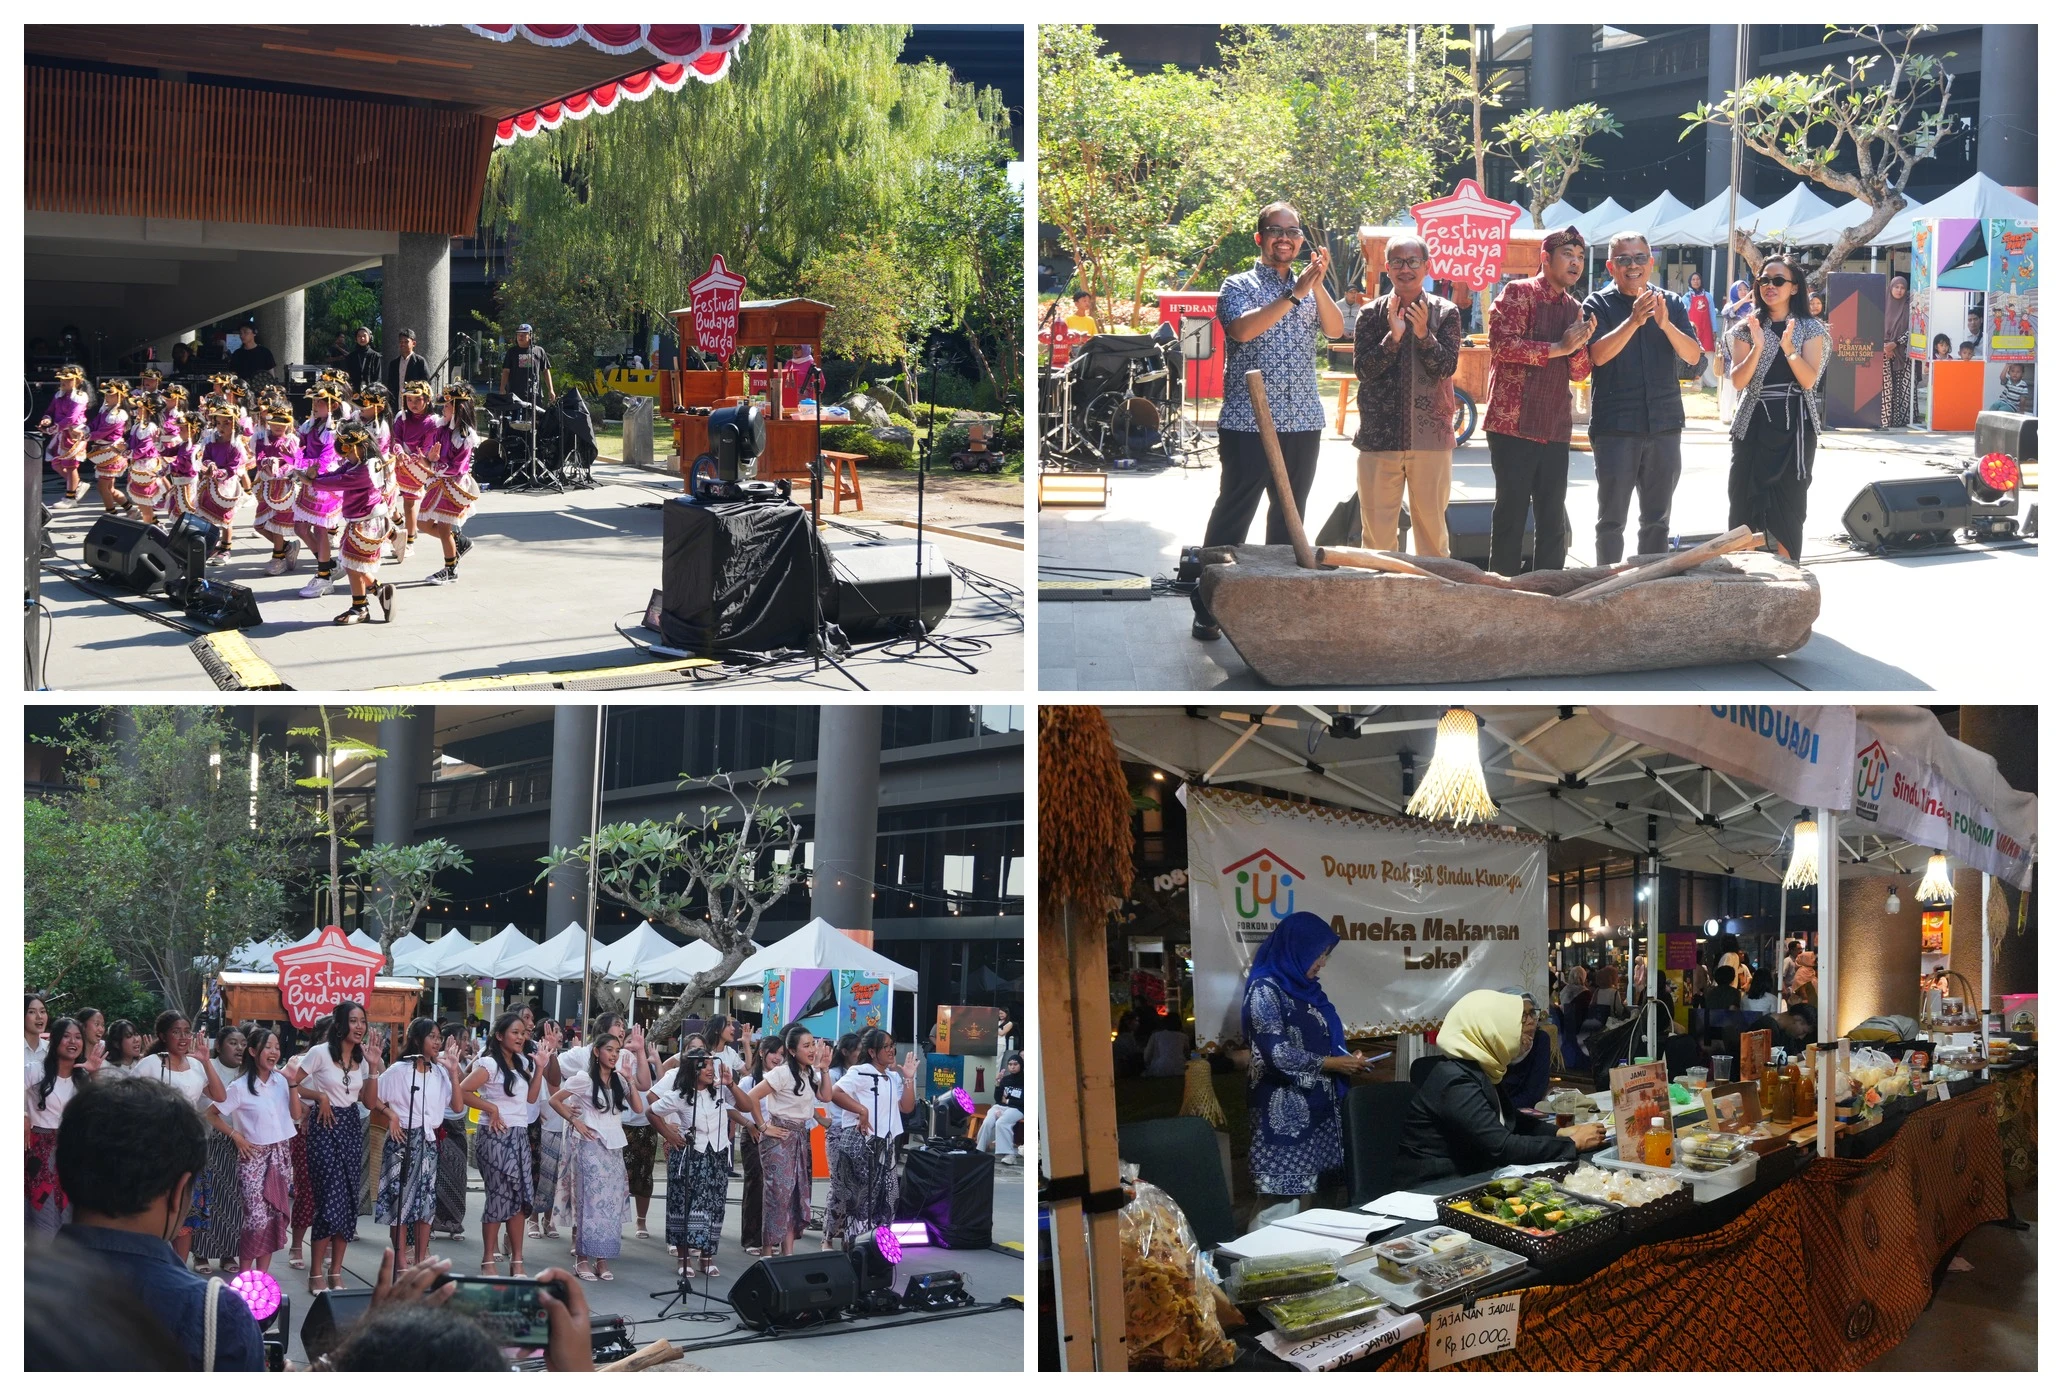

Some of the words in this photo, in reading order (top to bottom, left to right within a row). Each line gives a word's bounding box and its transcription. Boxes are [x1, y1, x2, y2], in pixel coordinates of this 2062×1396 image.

[1422, 215, 1506, 240] Festival
[1427, 237, 1501, 267] Budaya
[1431, 258, 1496, 286] Warga
[694, 289, 737, 314] Festival
[1169, 304, 1217, 313] HDRAN
[696, 311, 735, 338] Budaya
[699, 331, 733, 357] Warga
[1893, 772, 1920, 807] Sindu
[1321, 855, 1378, 885] Dapur
[1381, 860, 1435, 888] Rakyat
[1437, 864, 1474, 886] Sindu
[1237, 922, 1268, 930] FORKOM
[1330, 915, 1416, 941] Aneka
[1422, 918, 1519, 941] Makanan
[1404, 946, 1469, 970] Lokal
[284, 962, 370, 988] Festival
[1630, 1070, 1647, 1080] JAMU
[1436, 1307, 1484, 1330] JAJANAN
[1488, 1302, 1516, 1316] JADUL
[1359, 1327, 1401, 1355] JAMBU
